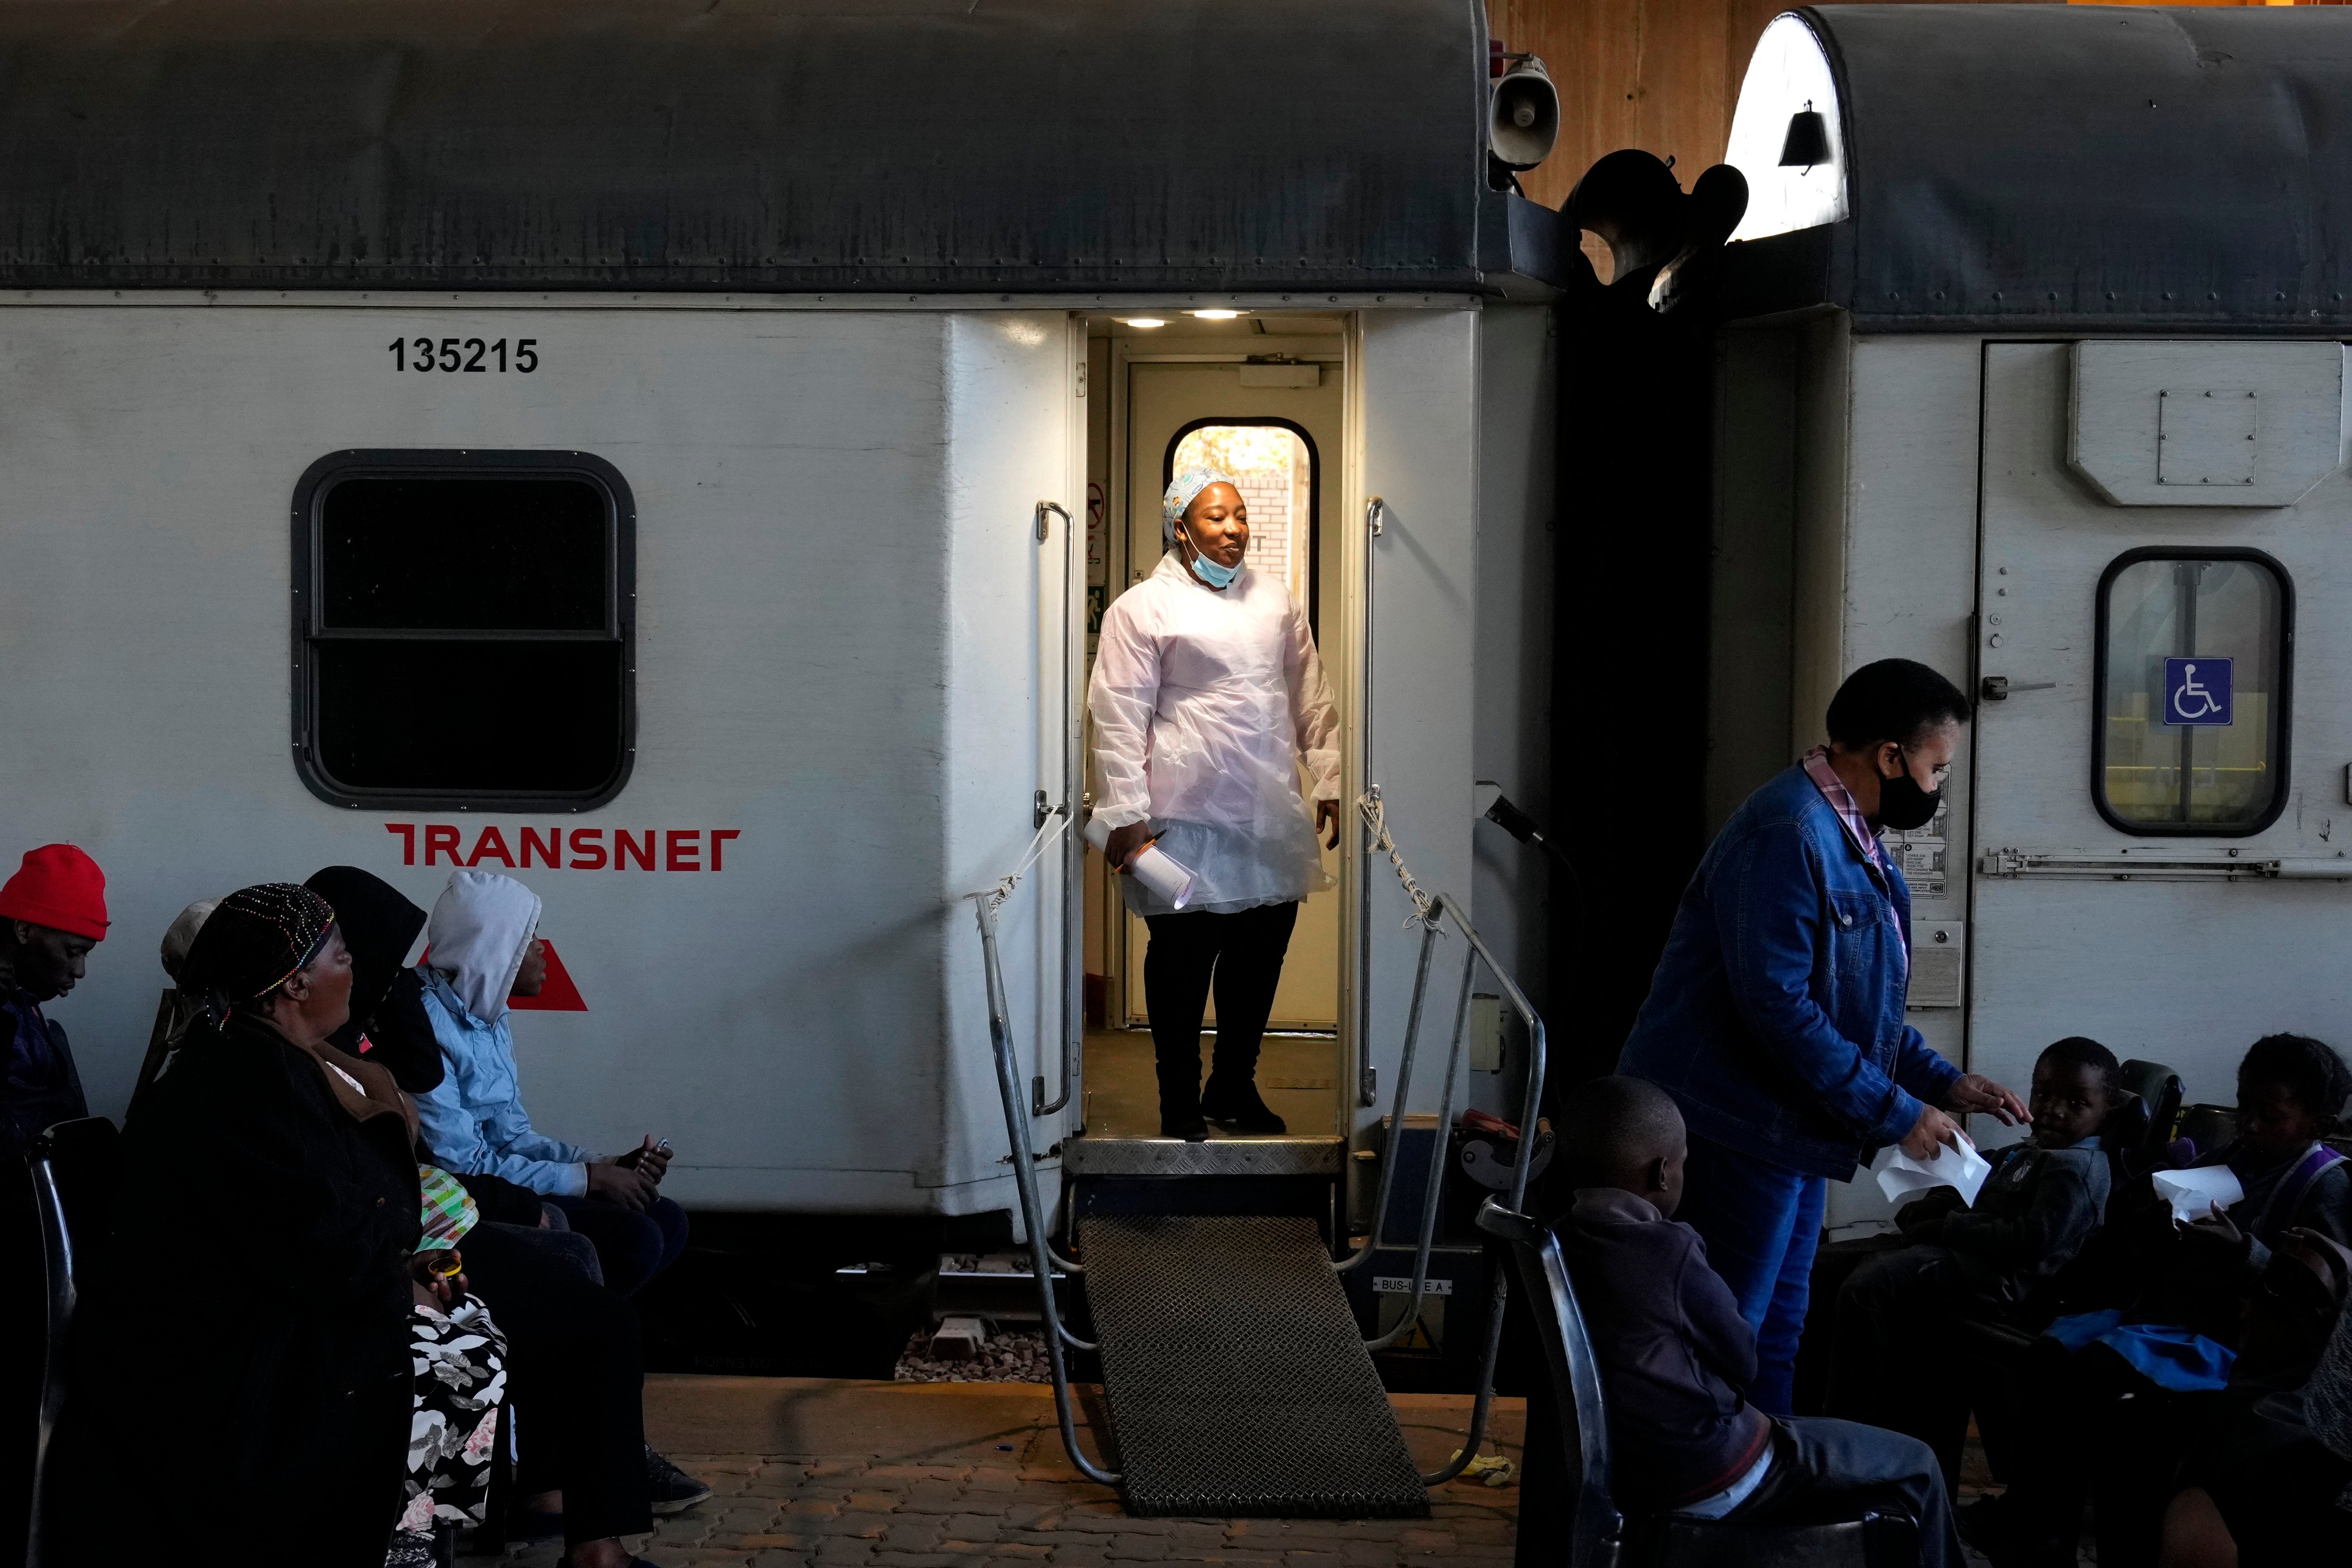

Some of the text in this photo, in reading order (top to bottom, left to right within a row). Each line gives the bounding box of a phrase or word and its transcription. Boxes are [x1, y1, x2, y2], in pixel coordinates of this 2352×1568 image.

[389, 338, 538, 373] 135215
[385, 824, 741, 871] TRANSNET
[1382, 1280, 1442, 1292] BUS-LE A
